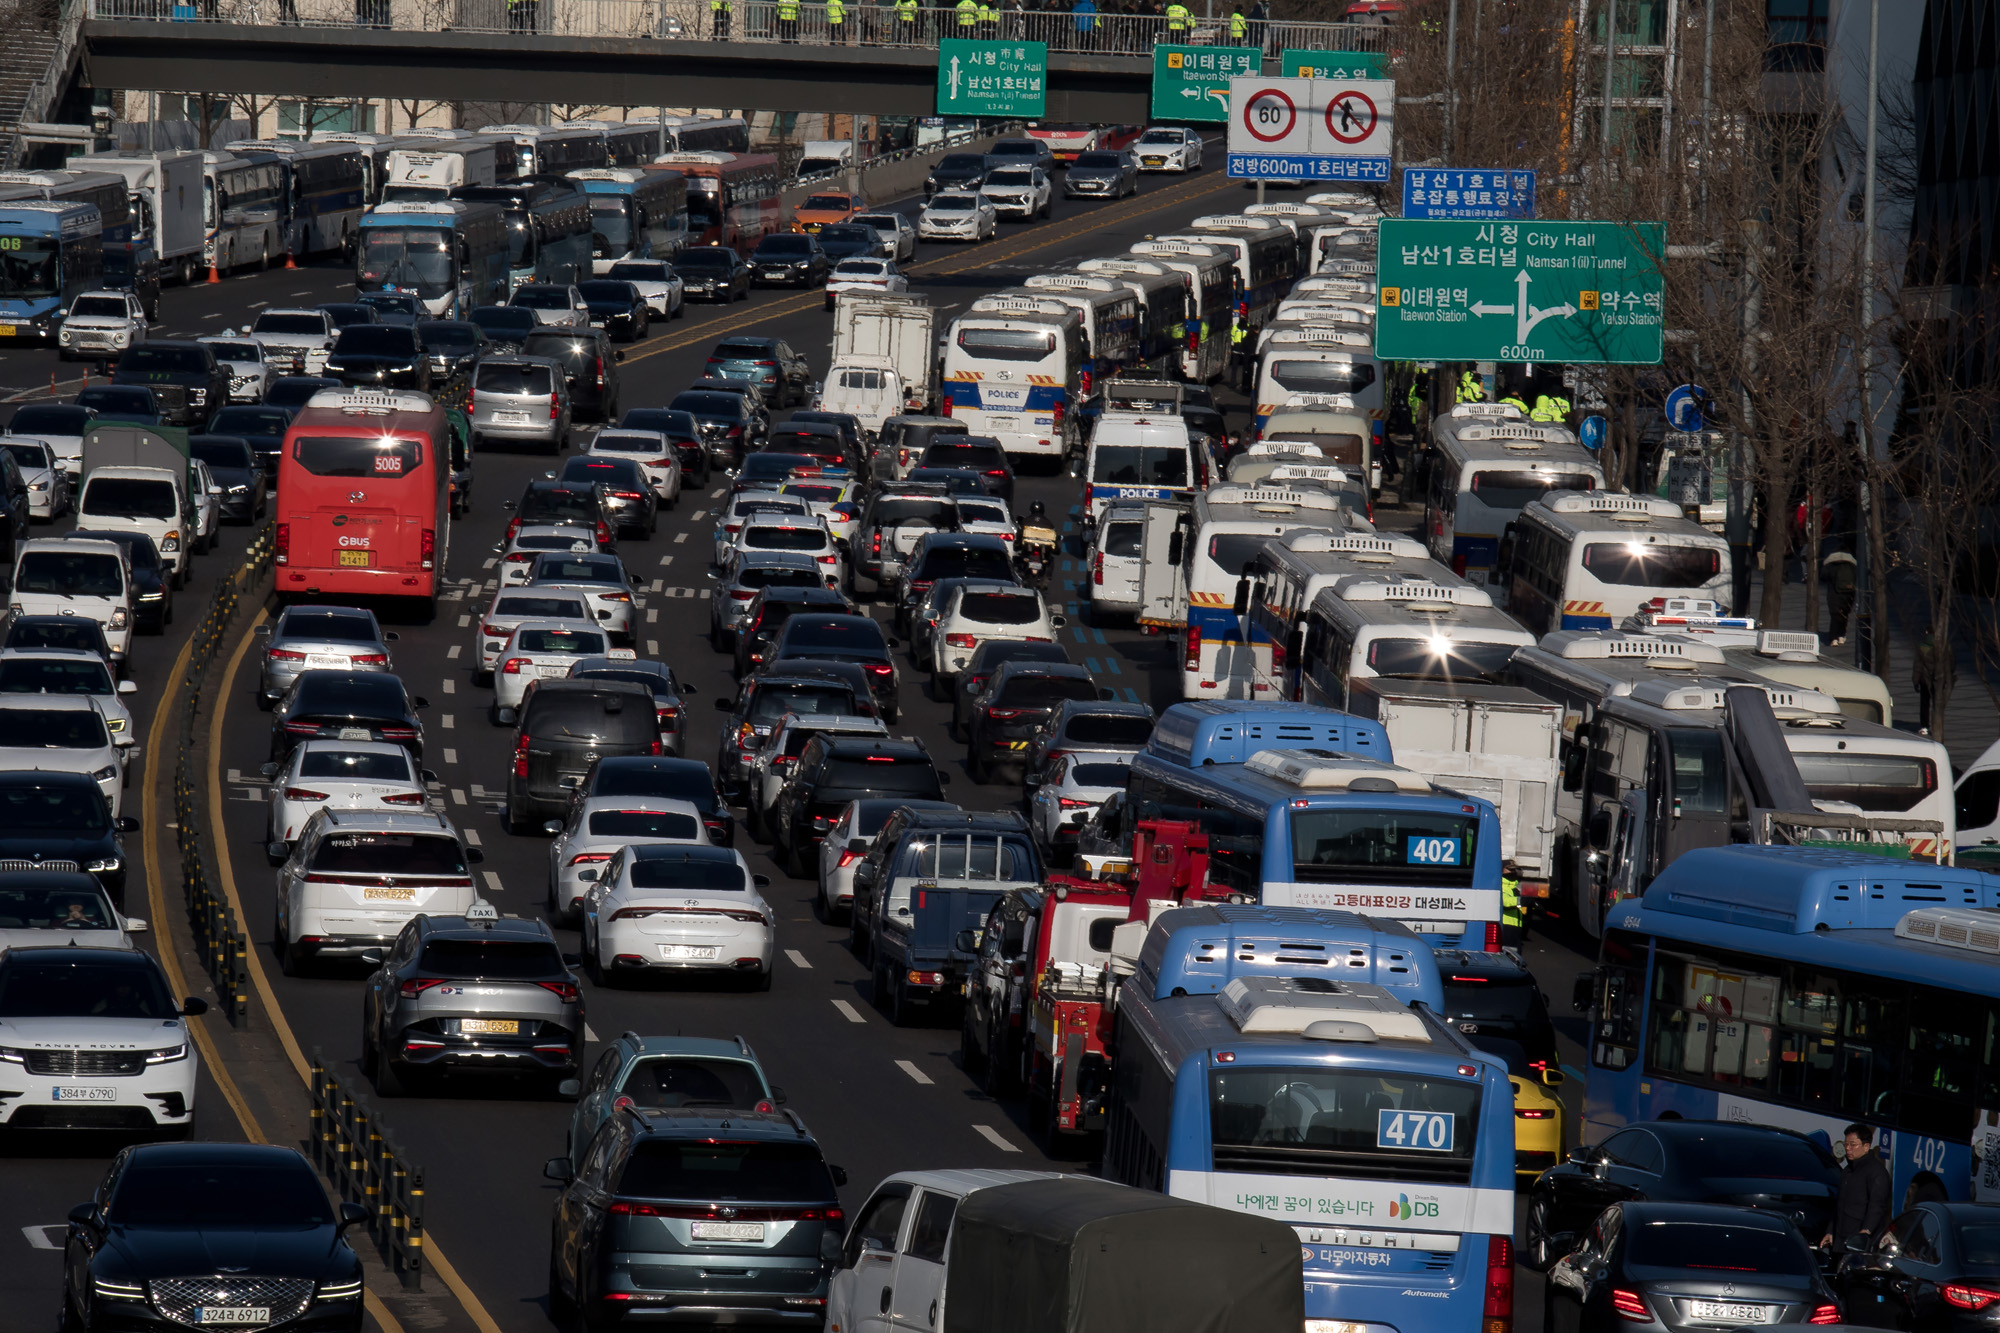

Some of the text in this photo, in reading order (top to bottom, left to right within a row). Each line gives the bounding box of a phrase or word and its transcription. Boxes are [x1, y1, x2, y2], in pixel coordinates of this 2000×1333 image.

[968, 51, 996, 66] 시청
[1183, 54, 1251, 70] 이태원역
[999, 61, 1042, 73] City Hall
[1182, 70, 1218, 80] Itaewon
[968, 76, 1041, 91] 남산1호터널
[967, 90, 999, 98] Namsan
[1015, 91, 1041, 100] Tunnel
[1259, 106, 1281, 124] 60
[1231, 158, 1388, 178] 전방600m 1호터널구간
[1410, 190, 1528, 206] 혼잡통행료징수
[1476, 224, 1518, 245] 시청
[1527, 233, 1596, 248] City Hall
[1402, 246, 1518, 268] 남산1호터널
[1526, 254, 1570, 269] Namsan
[1592, 256, 1627, 270] Tunnel
[1401, 288, 1468, 308] 이태원역
[1600, 290, 1661, 311] 약수역
[1401, 308, 1467, 322] Itaewon Station
[1600, 312, 1661, 326] Yaksu Station
[1500, 345, 1545, 360] 600m
[988, 390, 1020, 399] POLICE
[375, 456, 402, 471] 5005
[1120, 488, 1160, 499] POLICE
[1412, 838, 1456, 863] 402
[1334, 894, 1466, 911] 고등대표인강 대성패스
[473, 909, 494, 917] TAXI
[491, 1022, 515, 1032] 5367
[88, 1088, 114, 1099] 6790
[1385, 1112, 1447, 1148] 470
[1912, 1135, 1947, 1174] 402
[1236, 1194, 1374, 1216] 나에겐 꿈이 있습니다
[1414, 1202, 1440, 1217] DB
[1310, 1228, 1415, 1248] UNDAI
[1320, 1249, 1391, 1266] 다모아자동차
[1401, 1289, 1450, 1300] Automatic
[204, 1309, 267, 1322] 324라 6912
